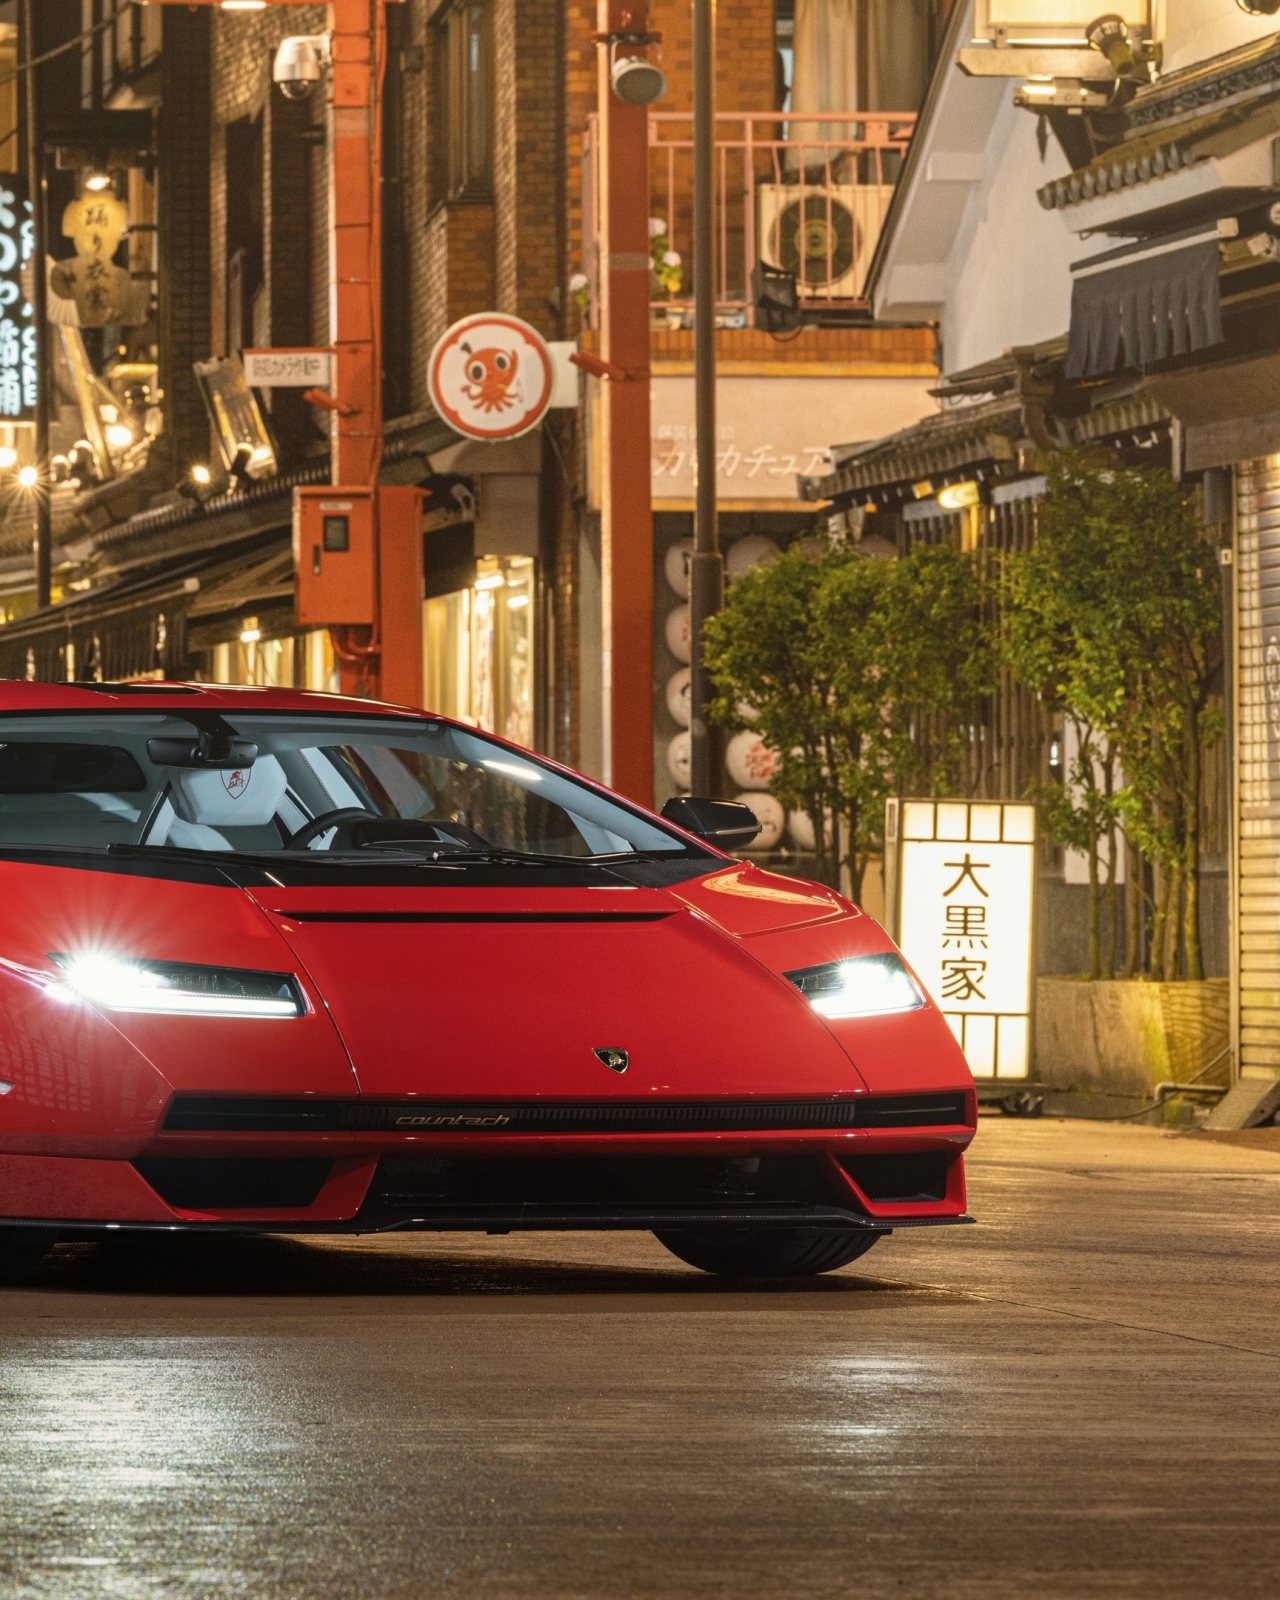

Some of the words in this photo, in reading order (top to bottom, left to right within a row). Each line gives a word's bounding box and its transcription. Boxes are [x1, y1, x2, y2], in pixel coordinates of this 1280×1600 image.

[942, 853, 990, 1000] 大黒家
[395, 1114, 510, 1126] countach
